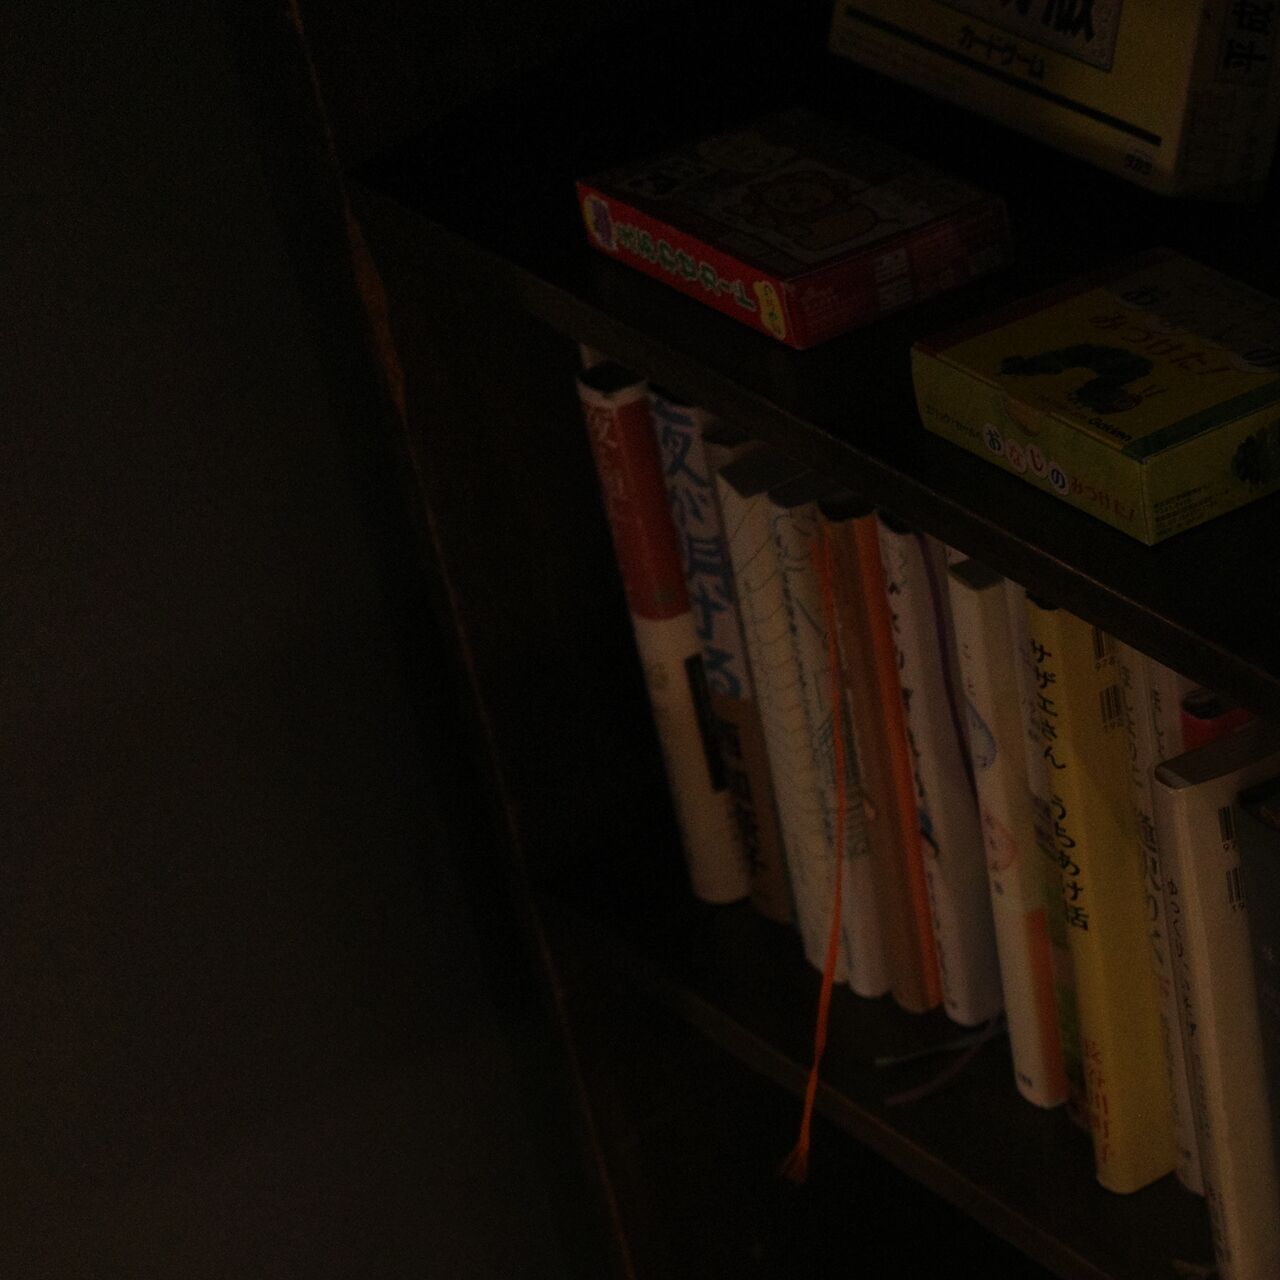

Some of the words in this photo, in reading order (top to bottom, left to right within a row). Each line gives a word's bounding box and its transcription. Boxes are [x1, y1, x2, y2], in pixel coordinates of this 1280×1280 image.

[956, 23, 1049, 81] カードゲーム
[1029, 638, 1067, 772] サザエさん
